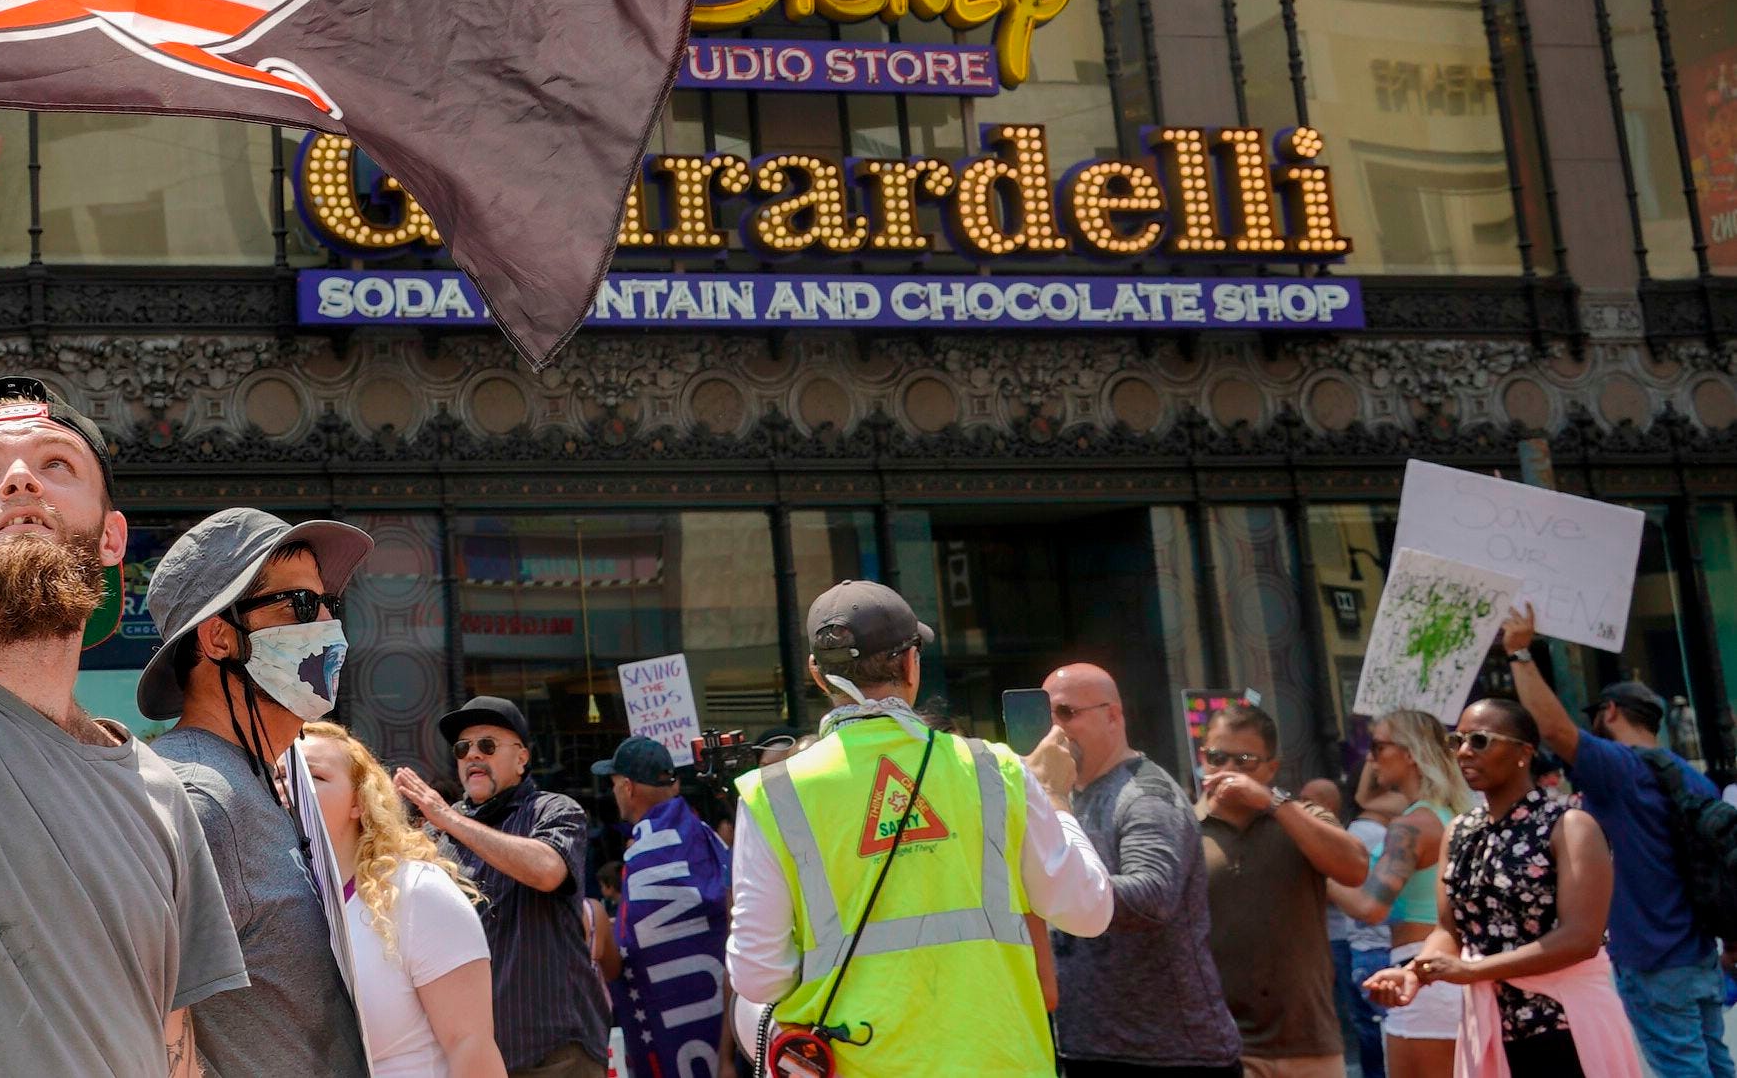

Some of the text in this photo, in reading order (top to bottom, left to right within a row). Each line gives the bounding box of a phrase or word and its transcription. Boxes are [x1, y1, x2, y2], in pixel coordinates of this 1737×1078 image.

[687, 45, 993, 87] UDIO STORE
[304, 124, 1356, 256] Grardelli
[317, 277, 475, 319] SODA
[774, 281, 882, 321] AND
[889, 281, 1204, 323] CHOCOLATE
[1212, 283, 1350, 322] SHOP
[623, 661, 681, 685] SAVING
[640, 682, 666, 694] THE
[627, 690, 682, 714] KIDS
[640, 708, 674, 723] IS A
